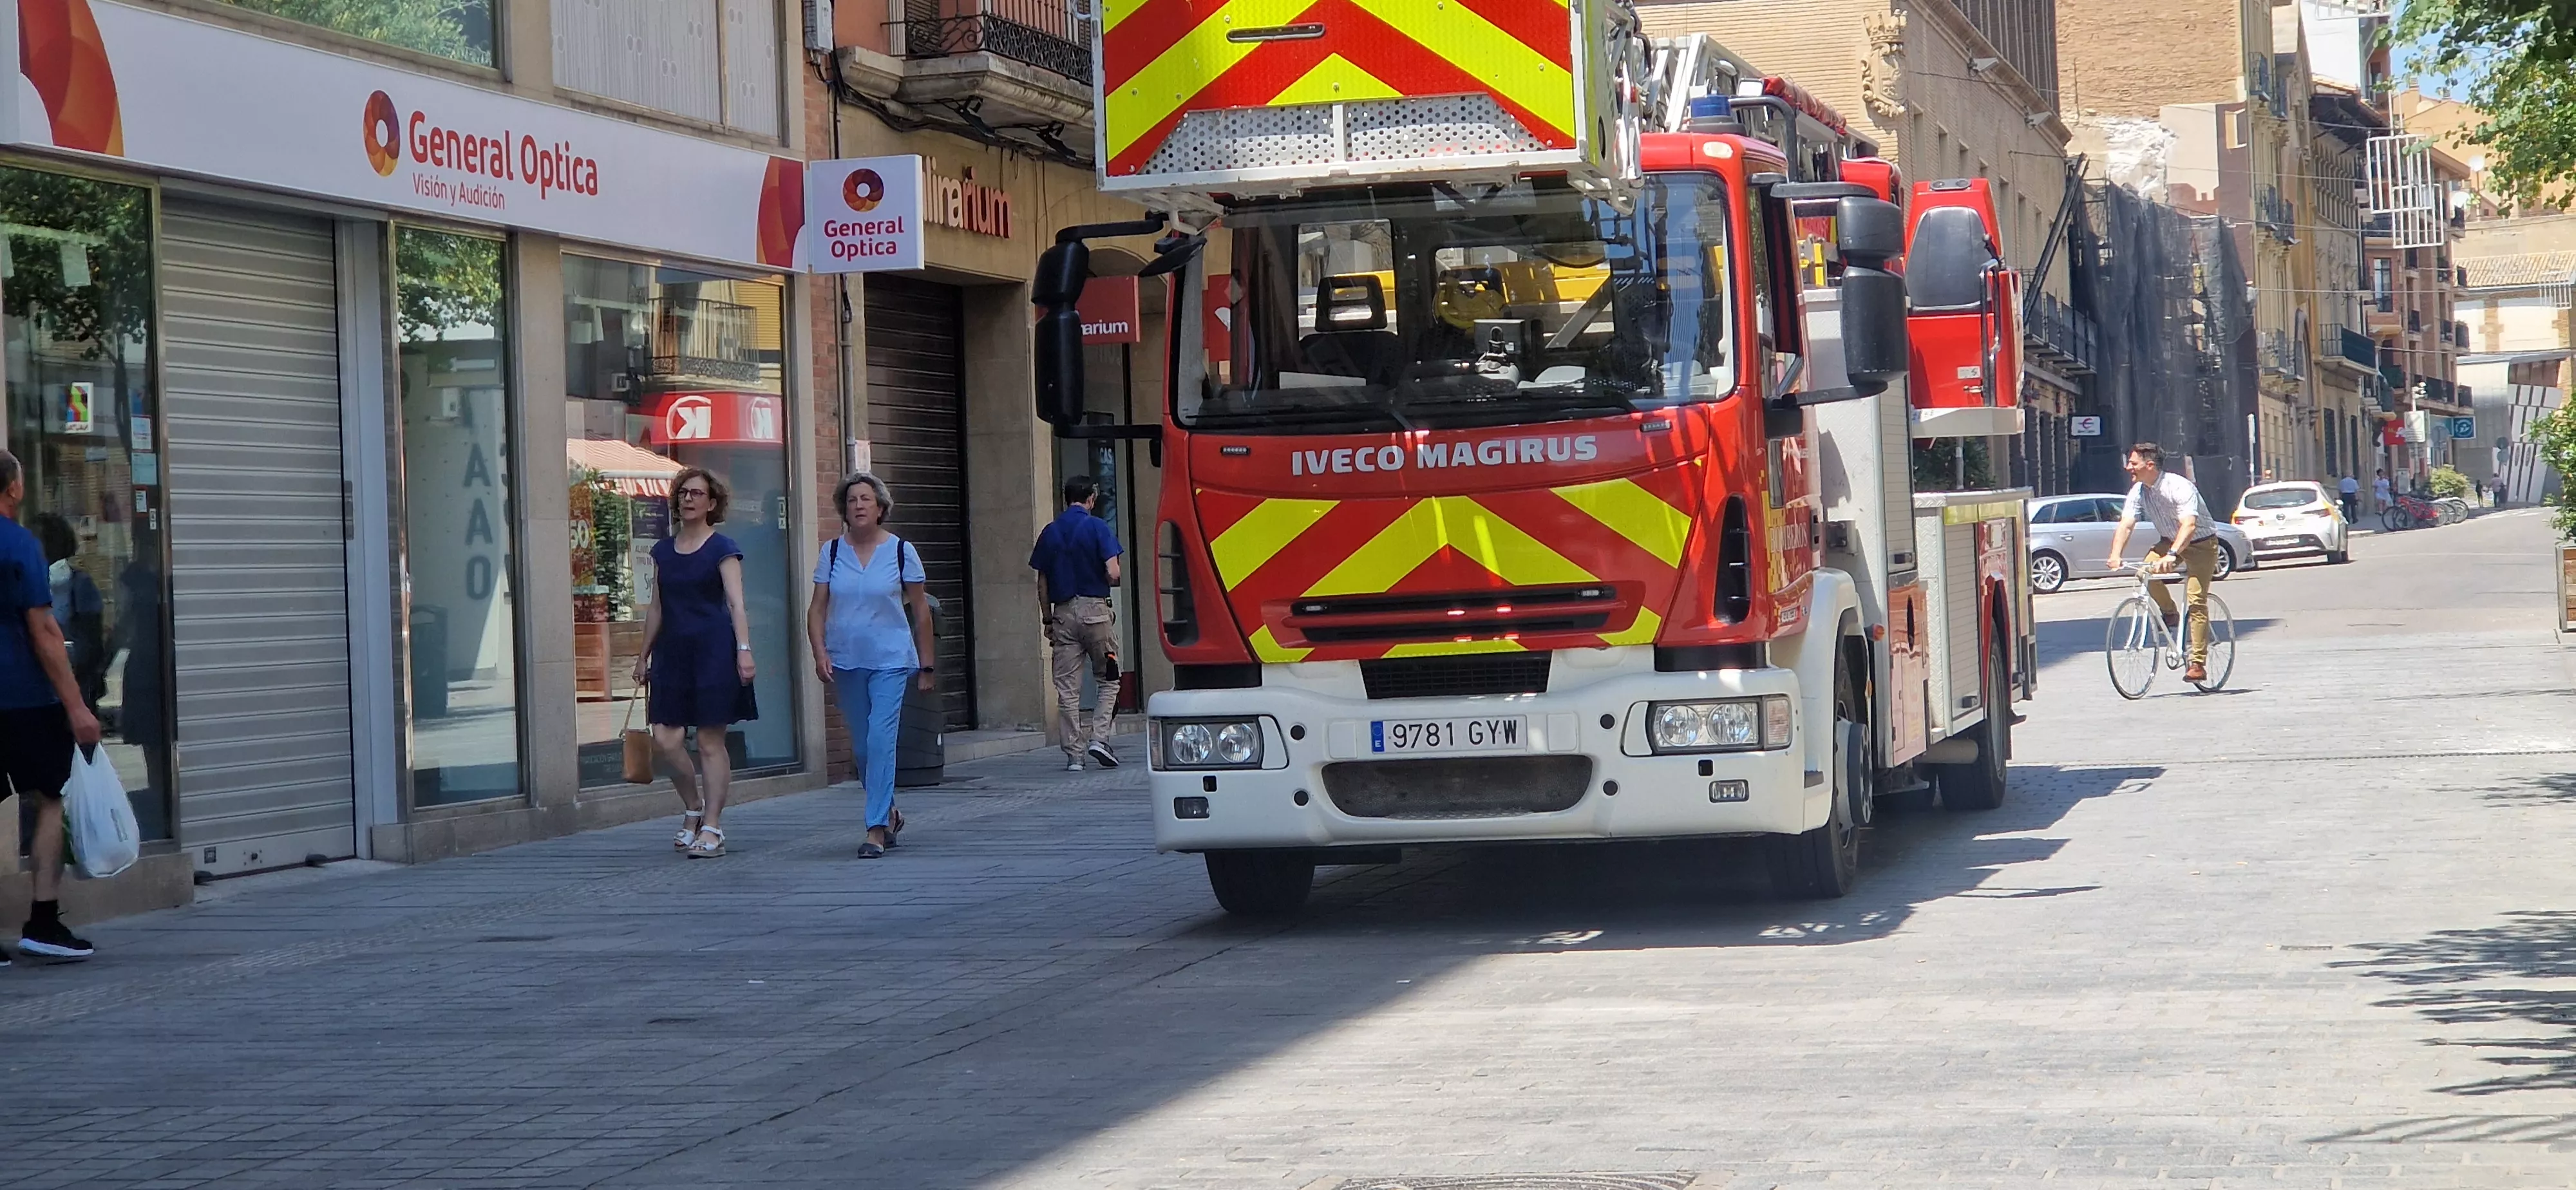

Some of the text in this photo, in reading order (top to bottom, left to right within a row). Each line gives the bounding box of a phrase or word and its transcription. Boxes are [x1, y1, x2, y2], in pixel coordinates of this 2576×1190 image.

[410, 110, 598, 200] General Optica
[413, 172, 506, 210] Visión y Audición
[824, 216, 904, 238] General
[831, 237, 896, 262] Optica
[1081, 319, 1128, 335] arium
[1292, 435, 1598, 476] IVECO MAGIRUS
[1770, 522, 1808, 552] BOMBEROS
[1393, 720, 1517, 748] 9781 GYW
